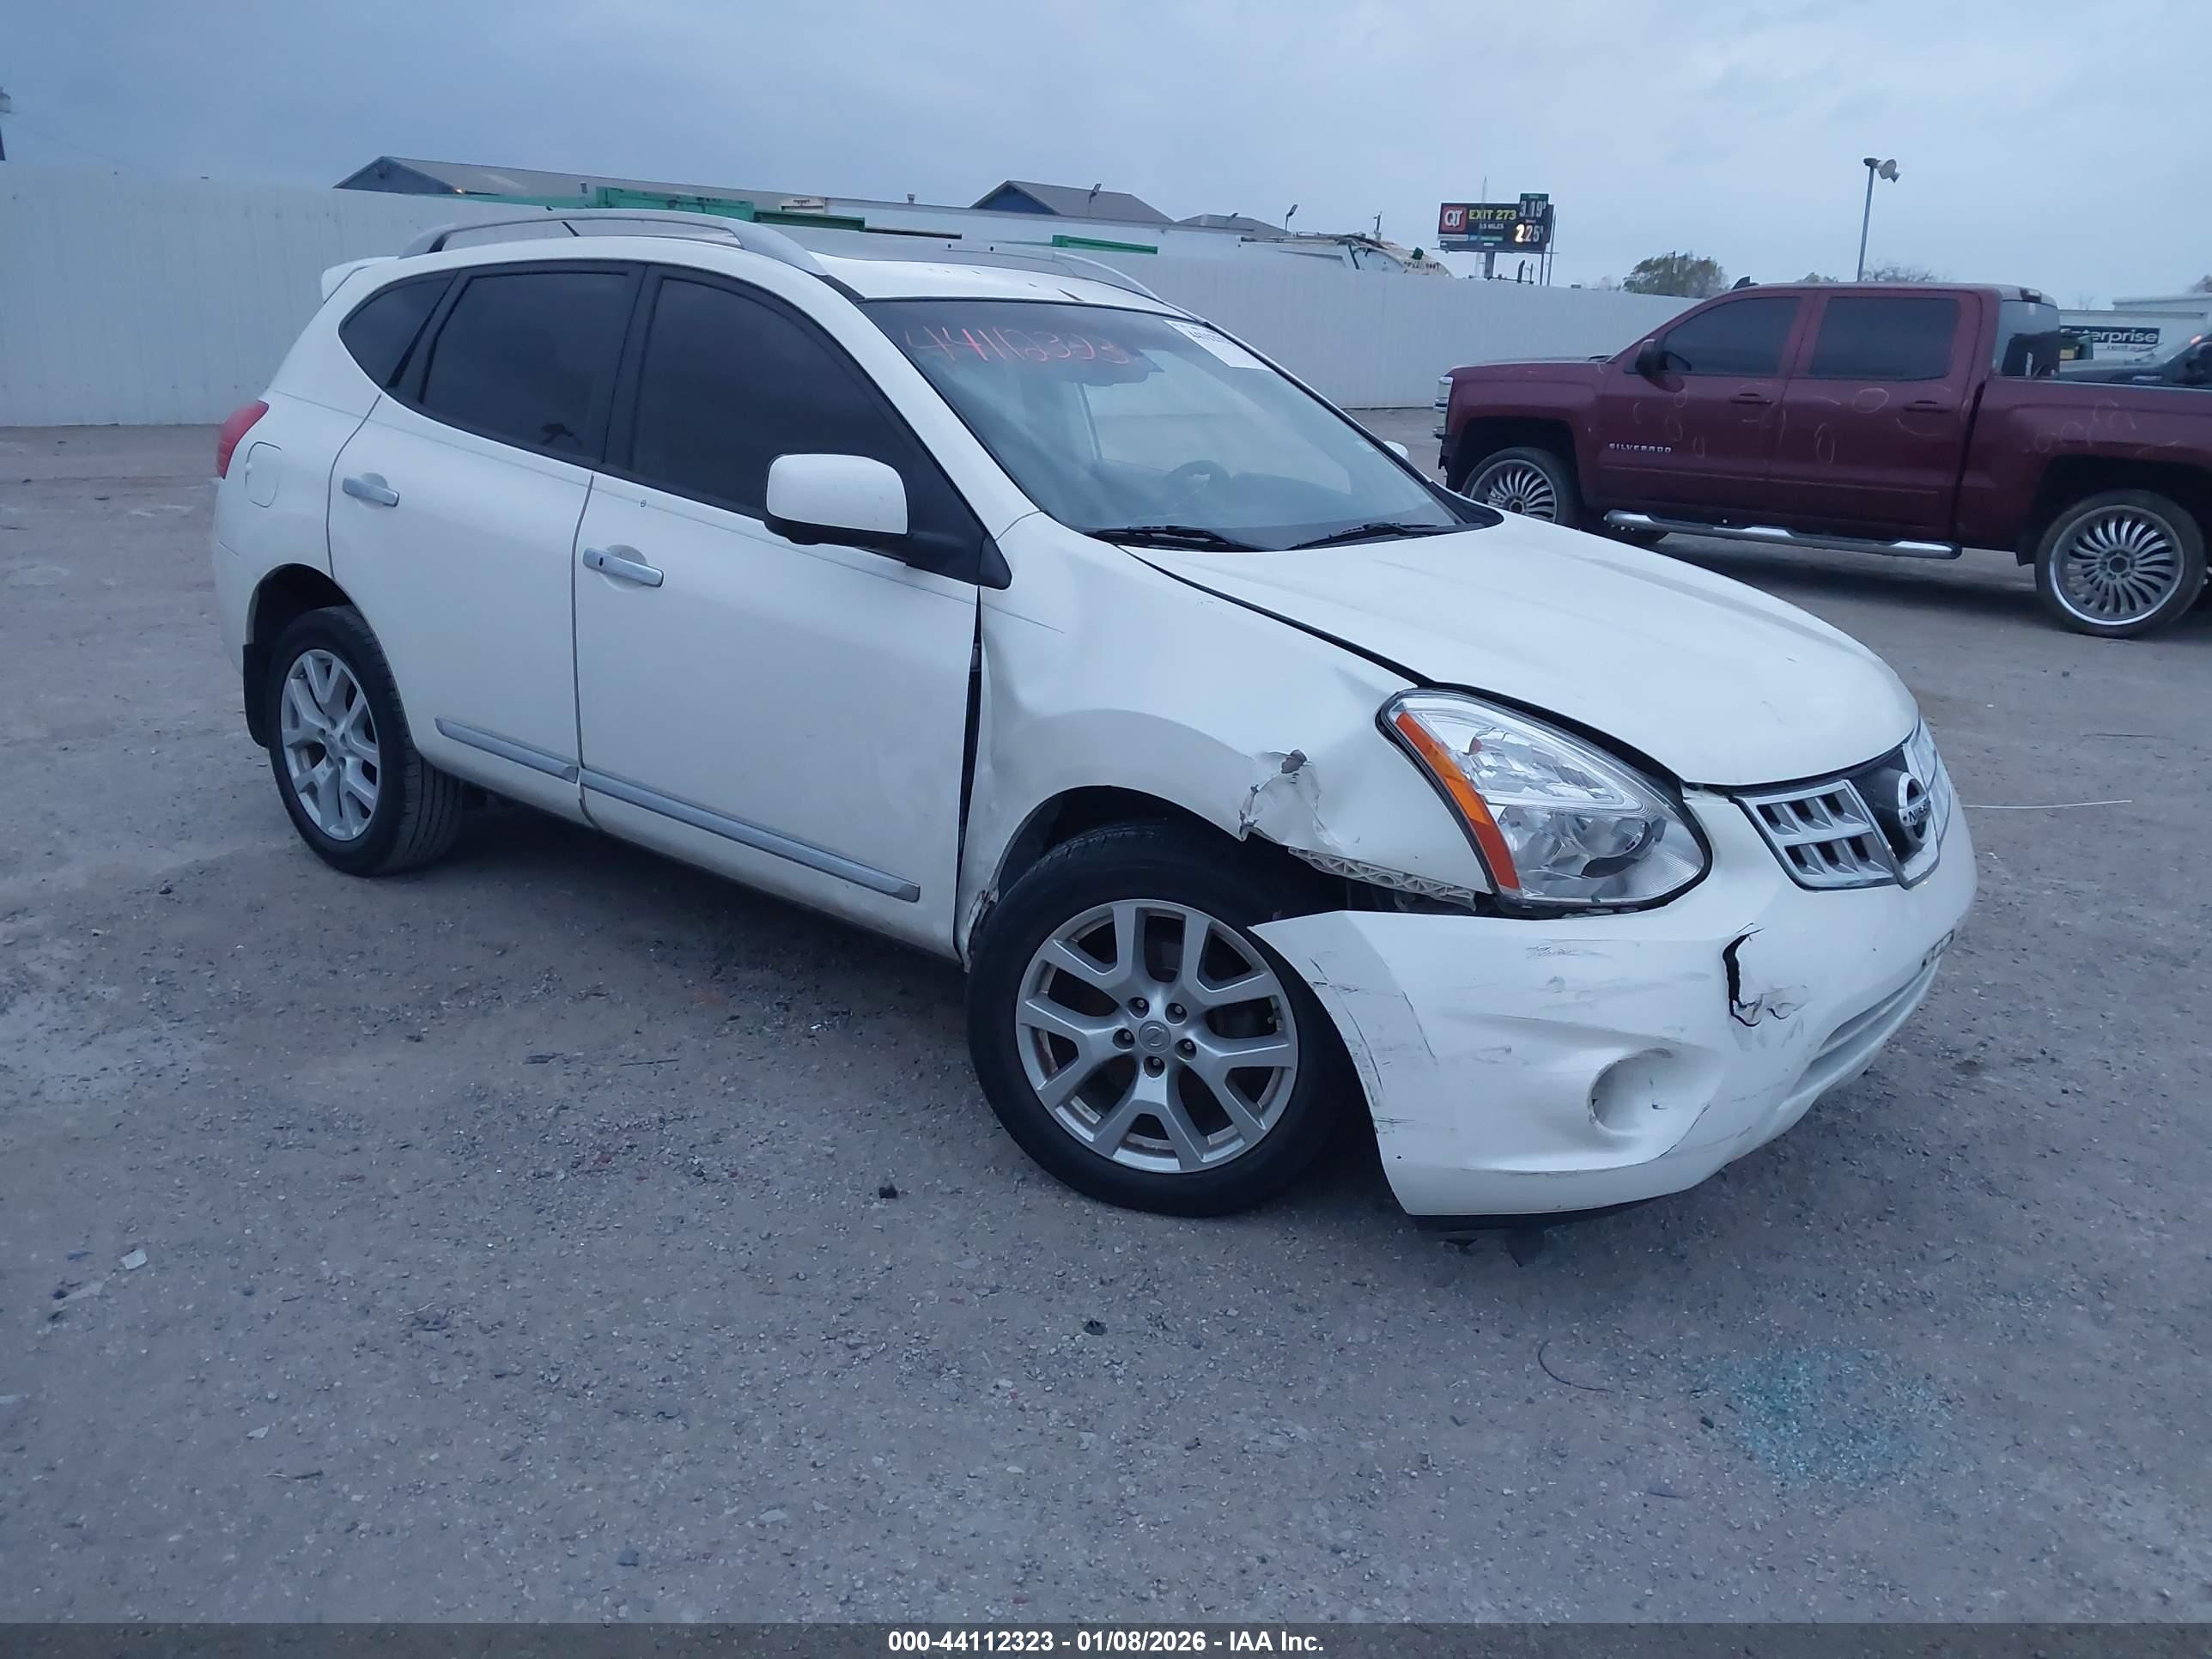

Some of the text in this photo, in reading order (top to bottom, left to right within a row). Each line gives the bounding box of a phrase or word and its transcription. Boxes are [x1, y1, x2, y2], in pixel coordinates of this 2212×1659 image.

[1444, 210, 1463, 227] QT
[1468, 210, 1517, 220] EXIT 273
[1608, 443, 1672, 453] SILVERADO
